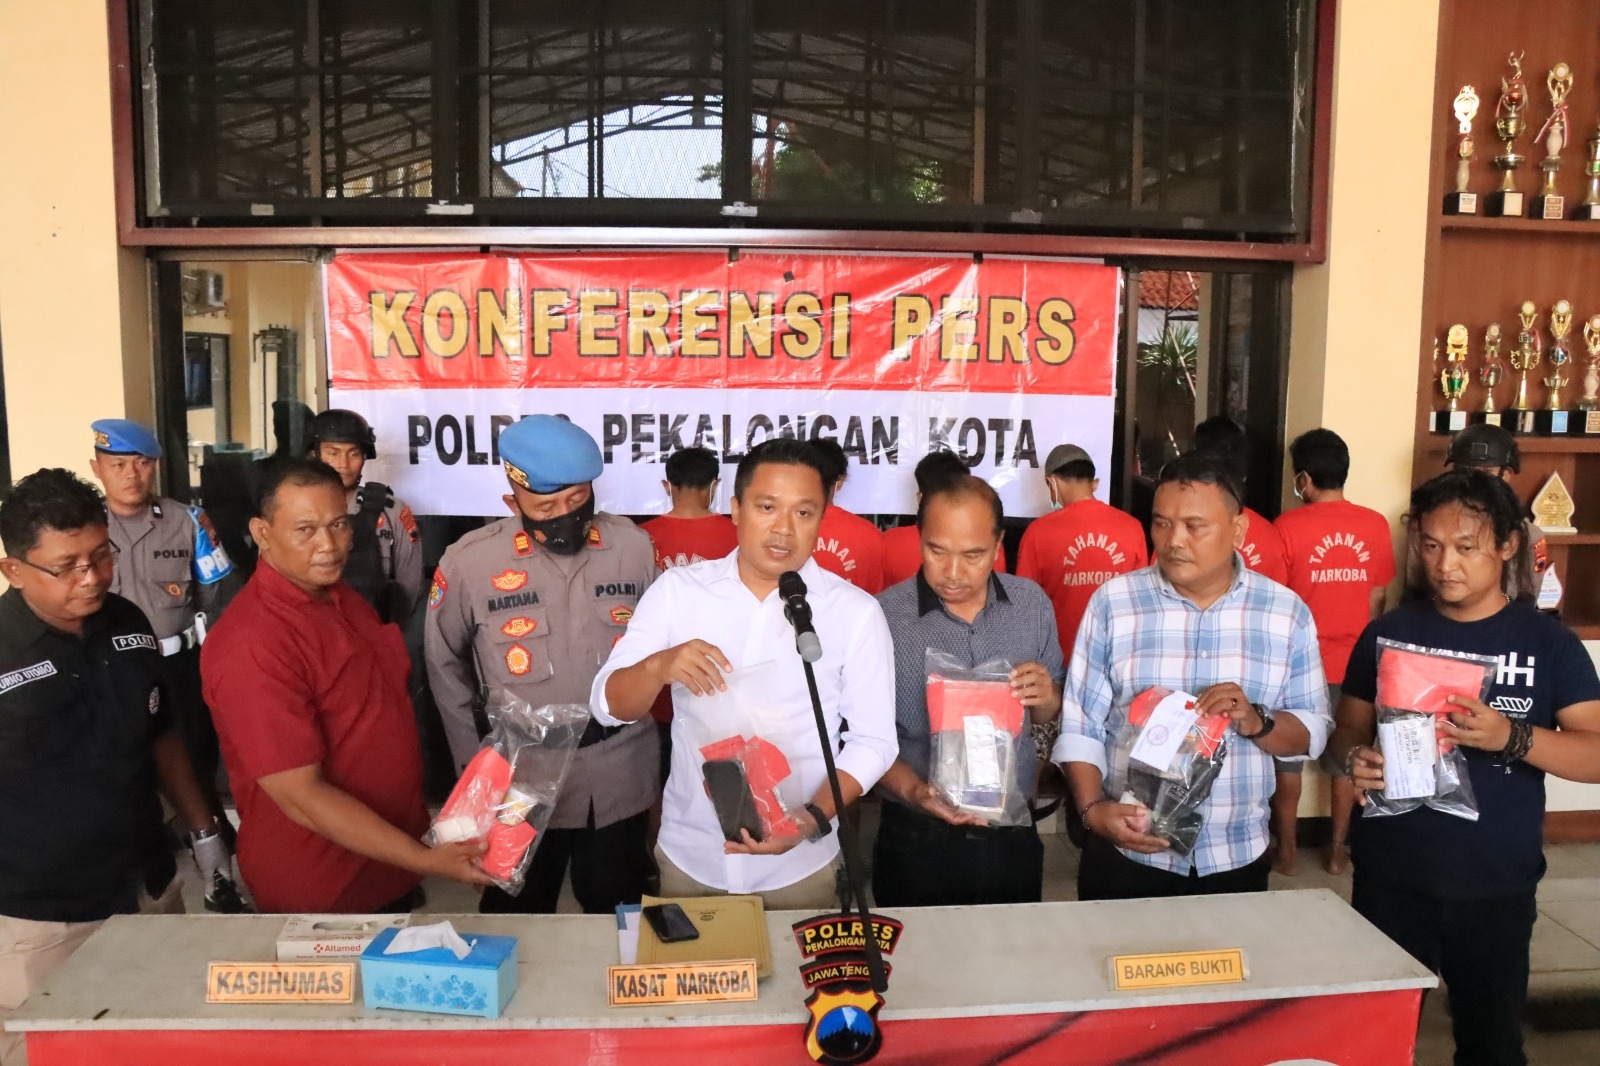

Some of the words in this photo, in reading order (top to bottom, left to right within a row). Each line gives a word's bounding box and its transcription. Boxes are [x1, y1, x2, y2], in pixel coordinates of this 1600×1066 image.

[368, 287, 852, 360] KONFERENSI
[892, 293, 1077, 365] PERS
[408, 413, 571, 466] POLR
[928, 416, 1039, 469] KOTA
[153, 549, 189, 559] POLRI
[1063, 532, 1126, 566] TAHANAN
[1309, 532, 1370, 564] TAHANAN
[1311, 568, 1368, 583] NARKOBA
[595, 582, 636, 598] POLRI
[488, 591, 539, 612] MARTANA
[22, 663, 52, 679] UTOMO
[324, 944, 361, 952] Altamed
[805, 937, 866, 954] PEKALONGAN
[808, 967, 839, 984] JAWA
[1124, 961, 1186, 979] BARANG
[1190, 959, 1233, 975] BUKTI
[216, 971, 344, 995] KASIHUMAS
[616, 973, 668, 998] KASAT
[676, 970, 751, 996] NARKOBA
